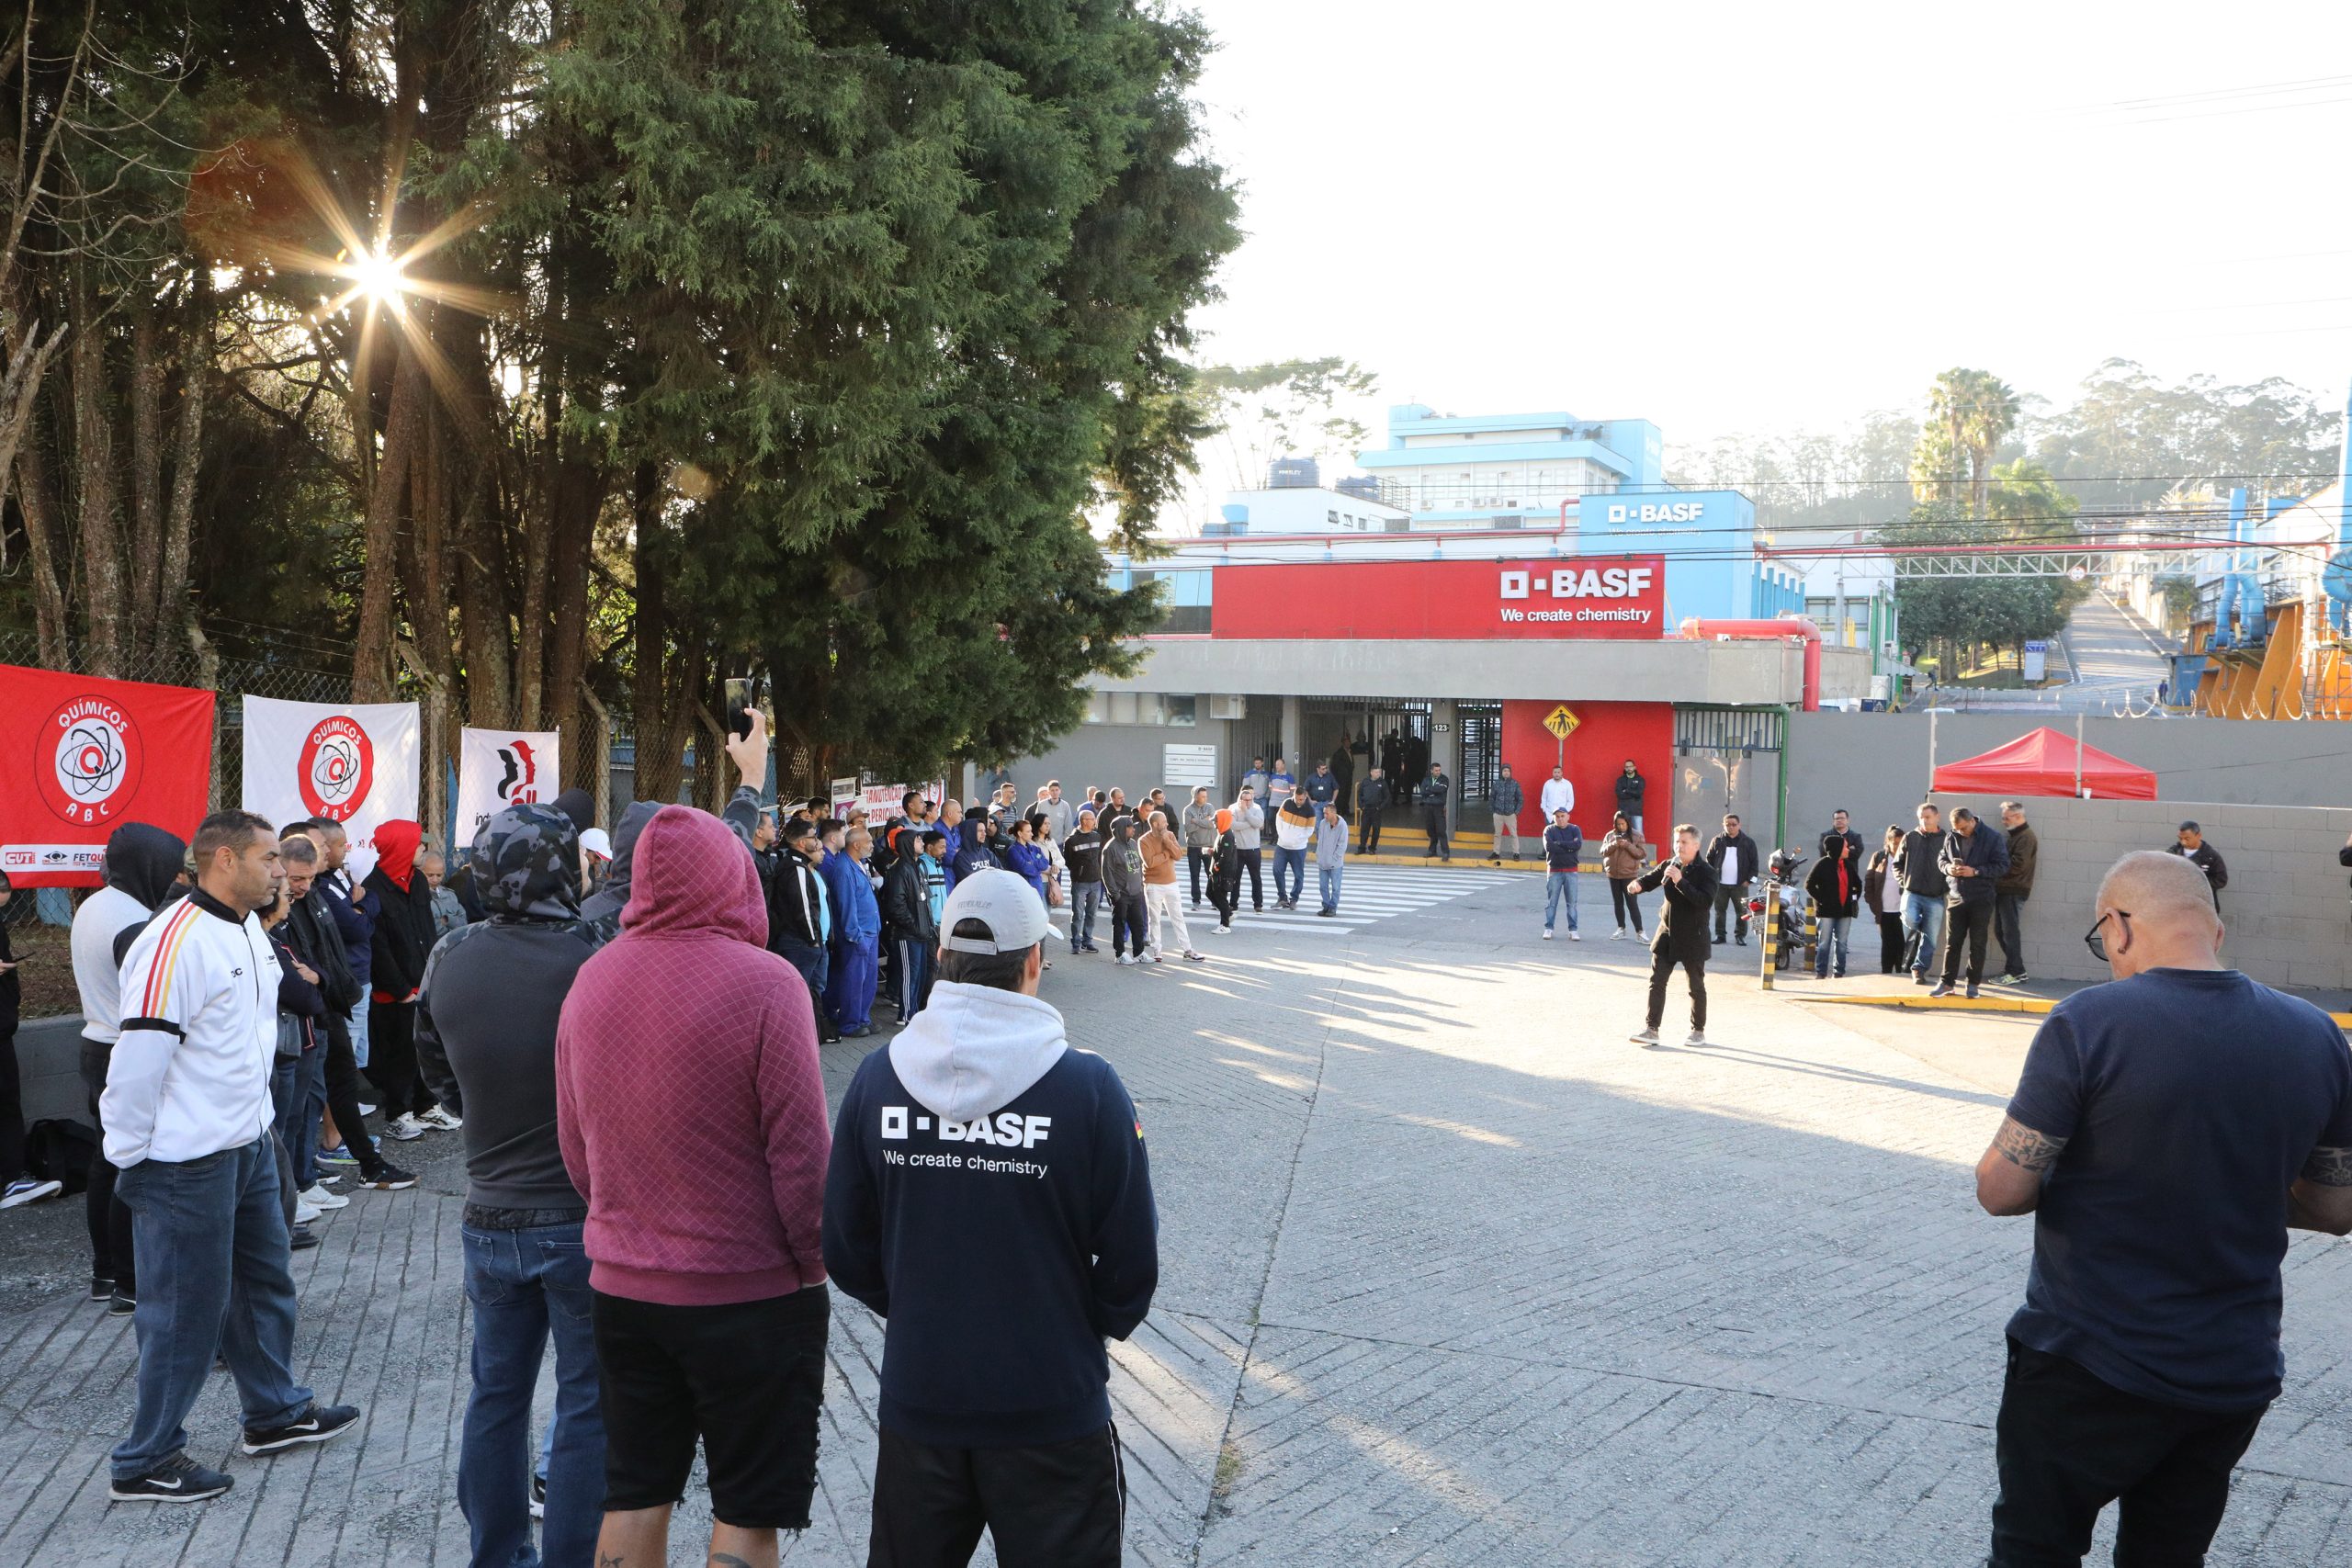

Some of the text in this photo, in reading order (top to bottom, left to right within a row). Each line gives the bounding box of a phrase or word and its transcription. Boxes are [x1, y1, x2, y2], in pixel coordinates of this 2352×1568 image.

[1641, 502, 1703, 523] BASF
[1552, 568, 1653, 598] BASF
[1500, 606, 1652, 624] We create chemistry
[59, 699, 128, 733] QUÍMICOS
[312, 718, 363, 745] QUÍMICOS
[6, 852, 32, 864] CUT
[938, 1112, 1052, 1149] BASF
[882, 1149, 1048, 1179] We create chemistry
